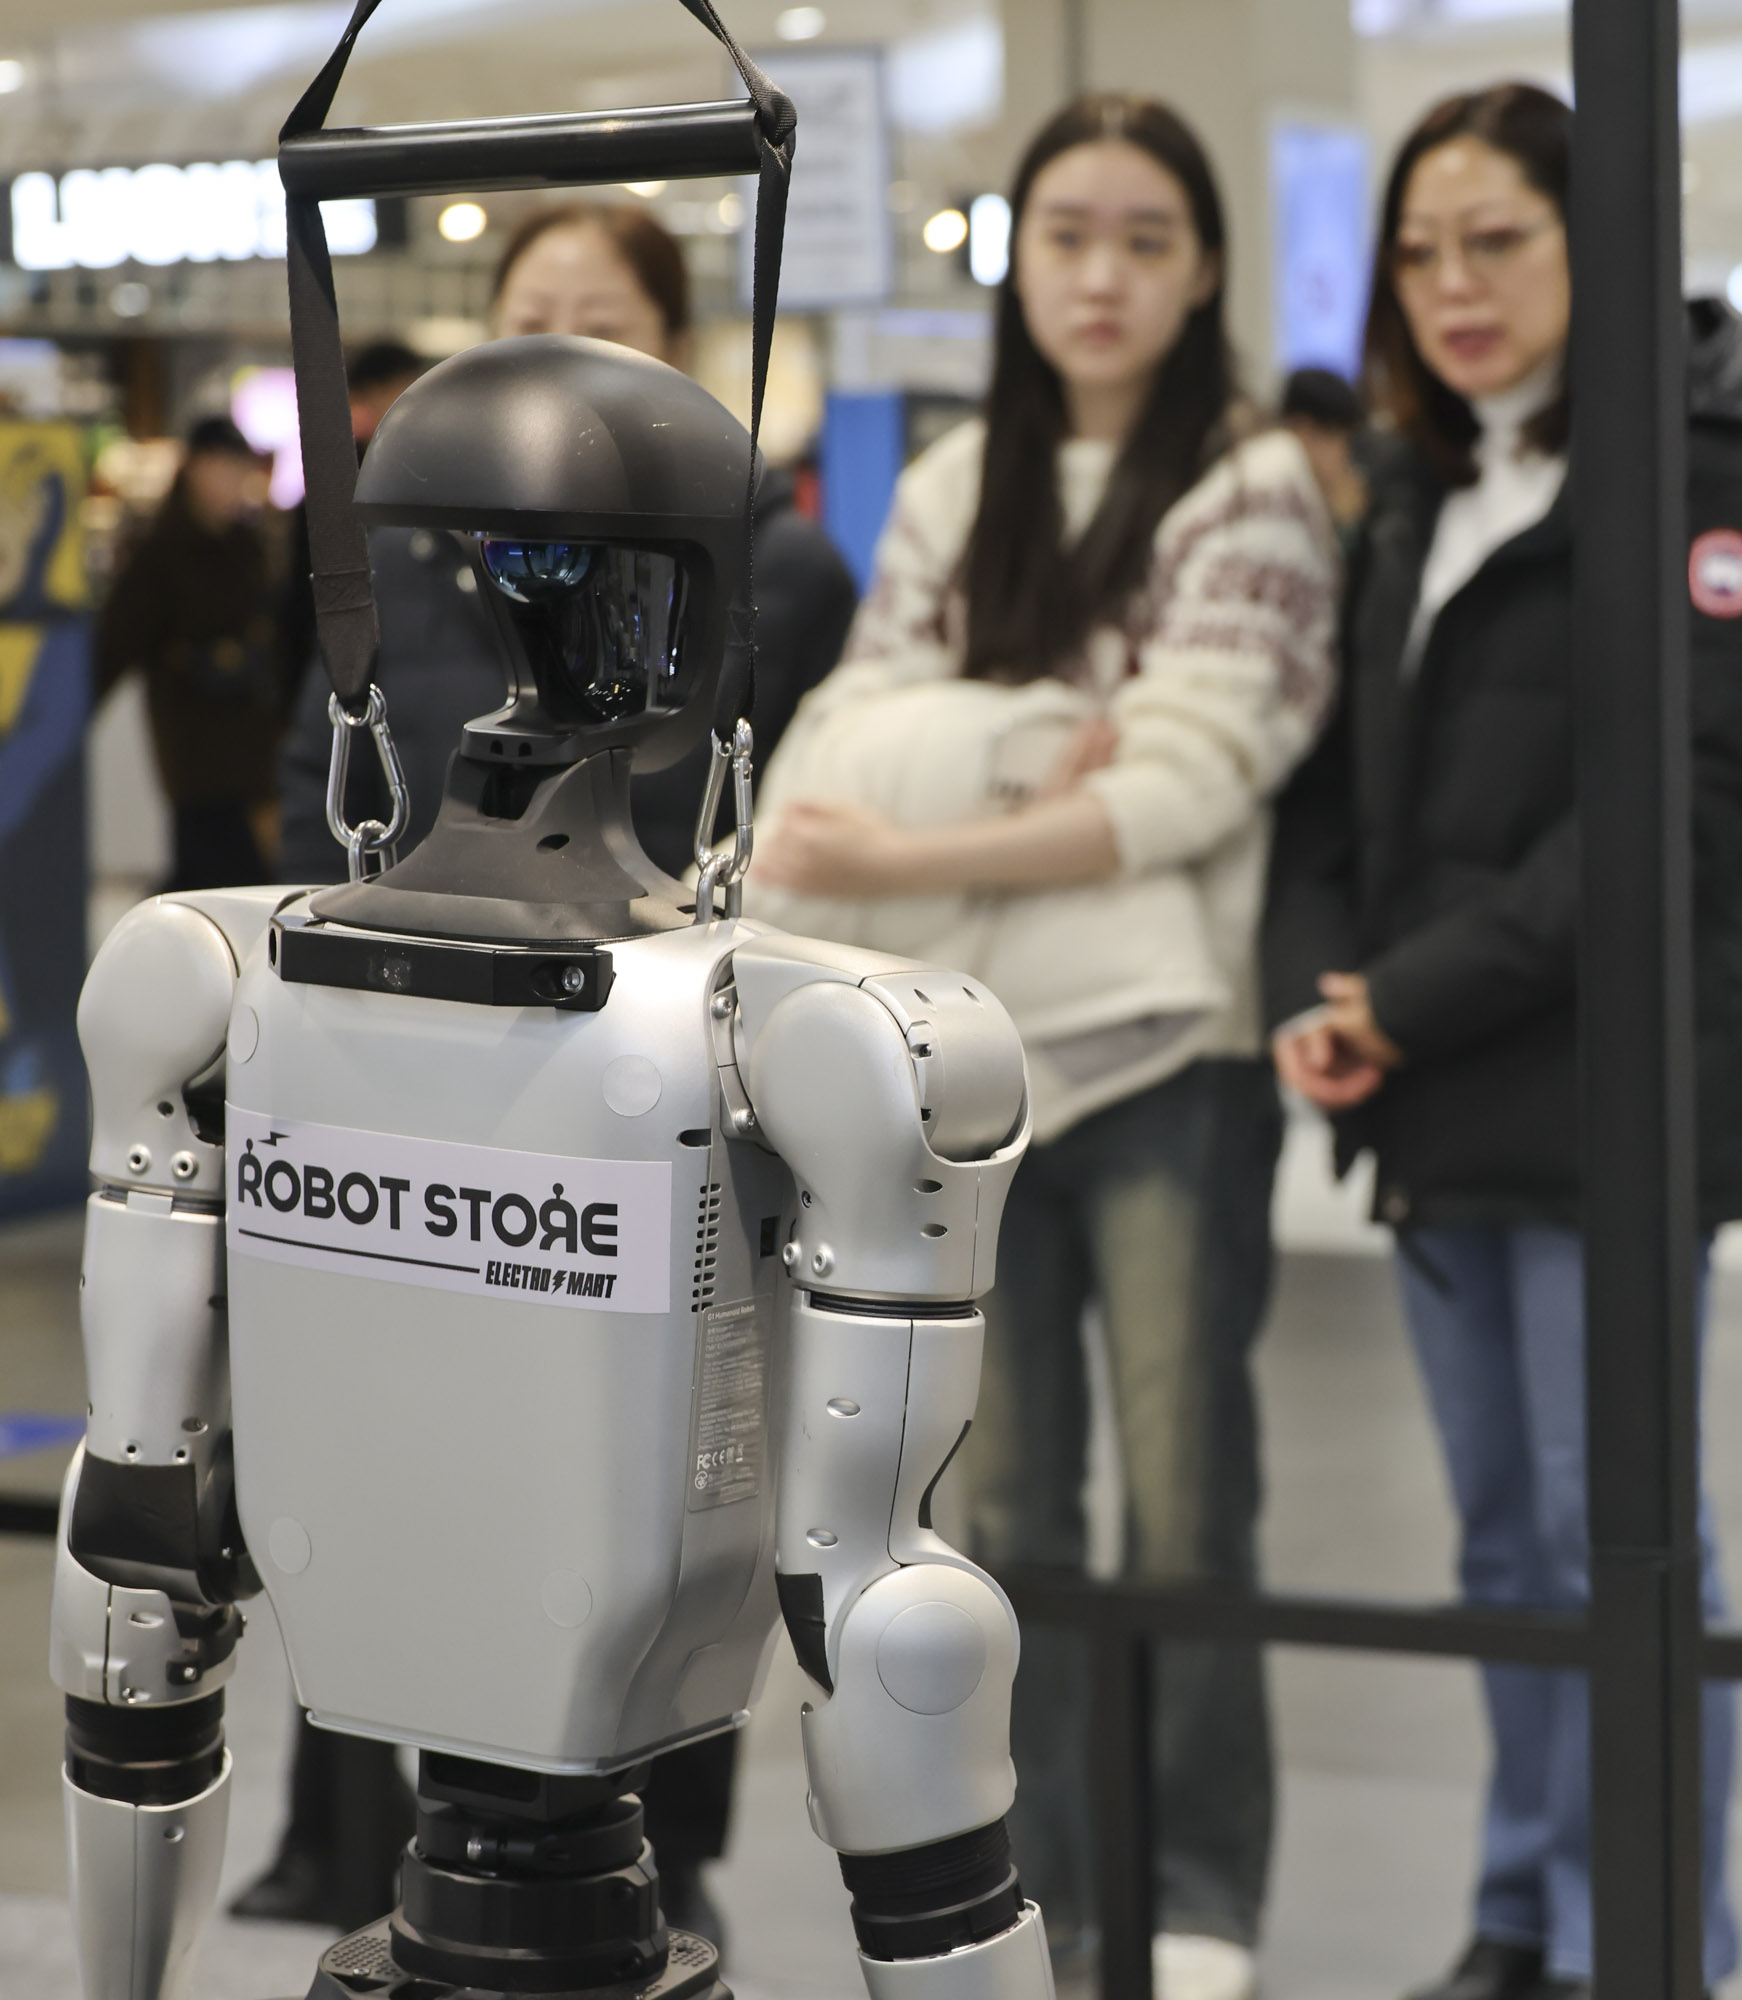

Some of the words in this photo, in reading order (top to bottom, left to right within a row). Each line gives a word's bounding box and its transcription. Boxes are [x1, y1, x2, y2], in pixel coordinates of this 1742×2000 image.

[238, 1139, 410, 1230] ROBOT
[424, 1183, 618, 1257] STORE
[485, 1260, 550, 1294] ELECTRO
[566, 1271, 618, 1298] MART
